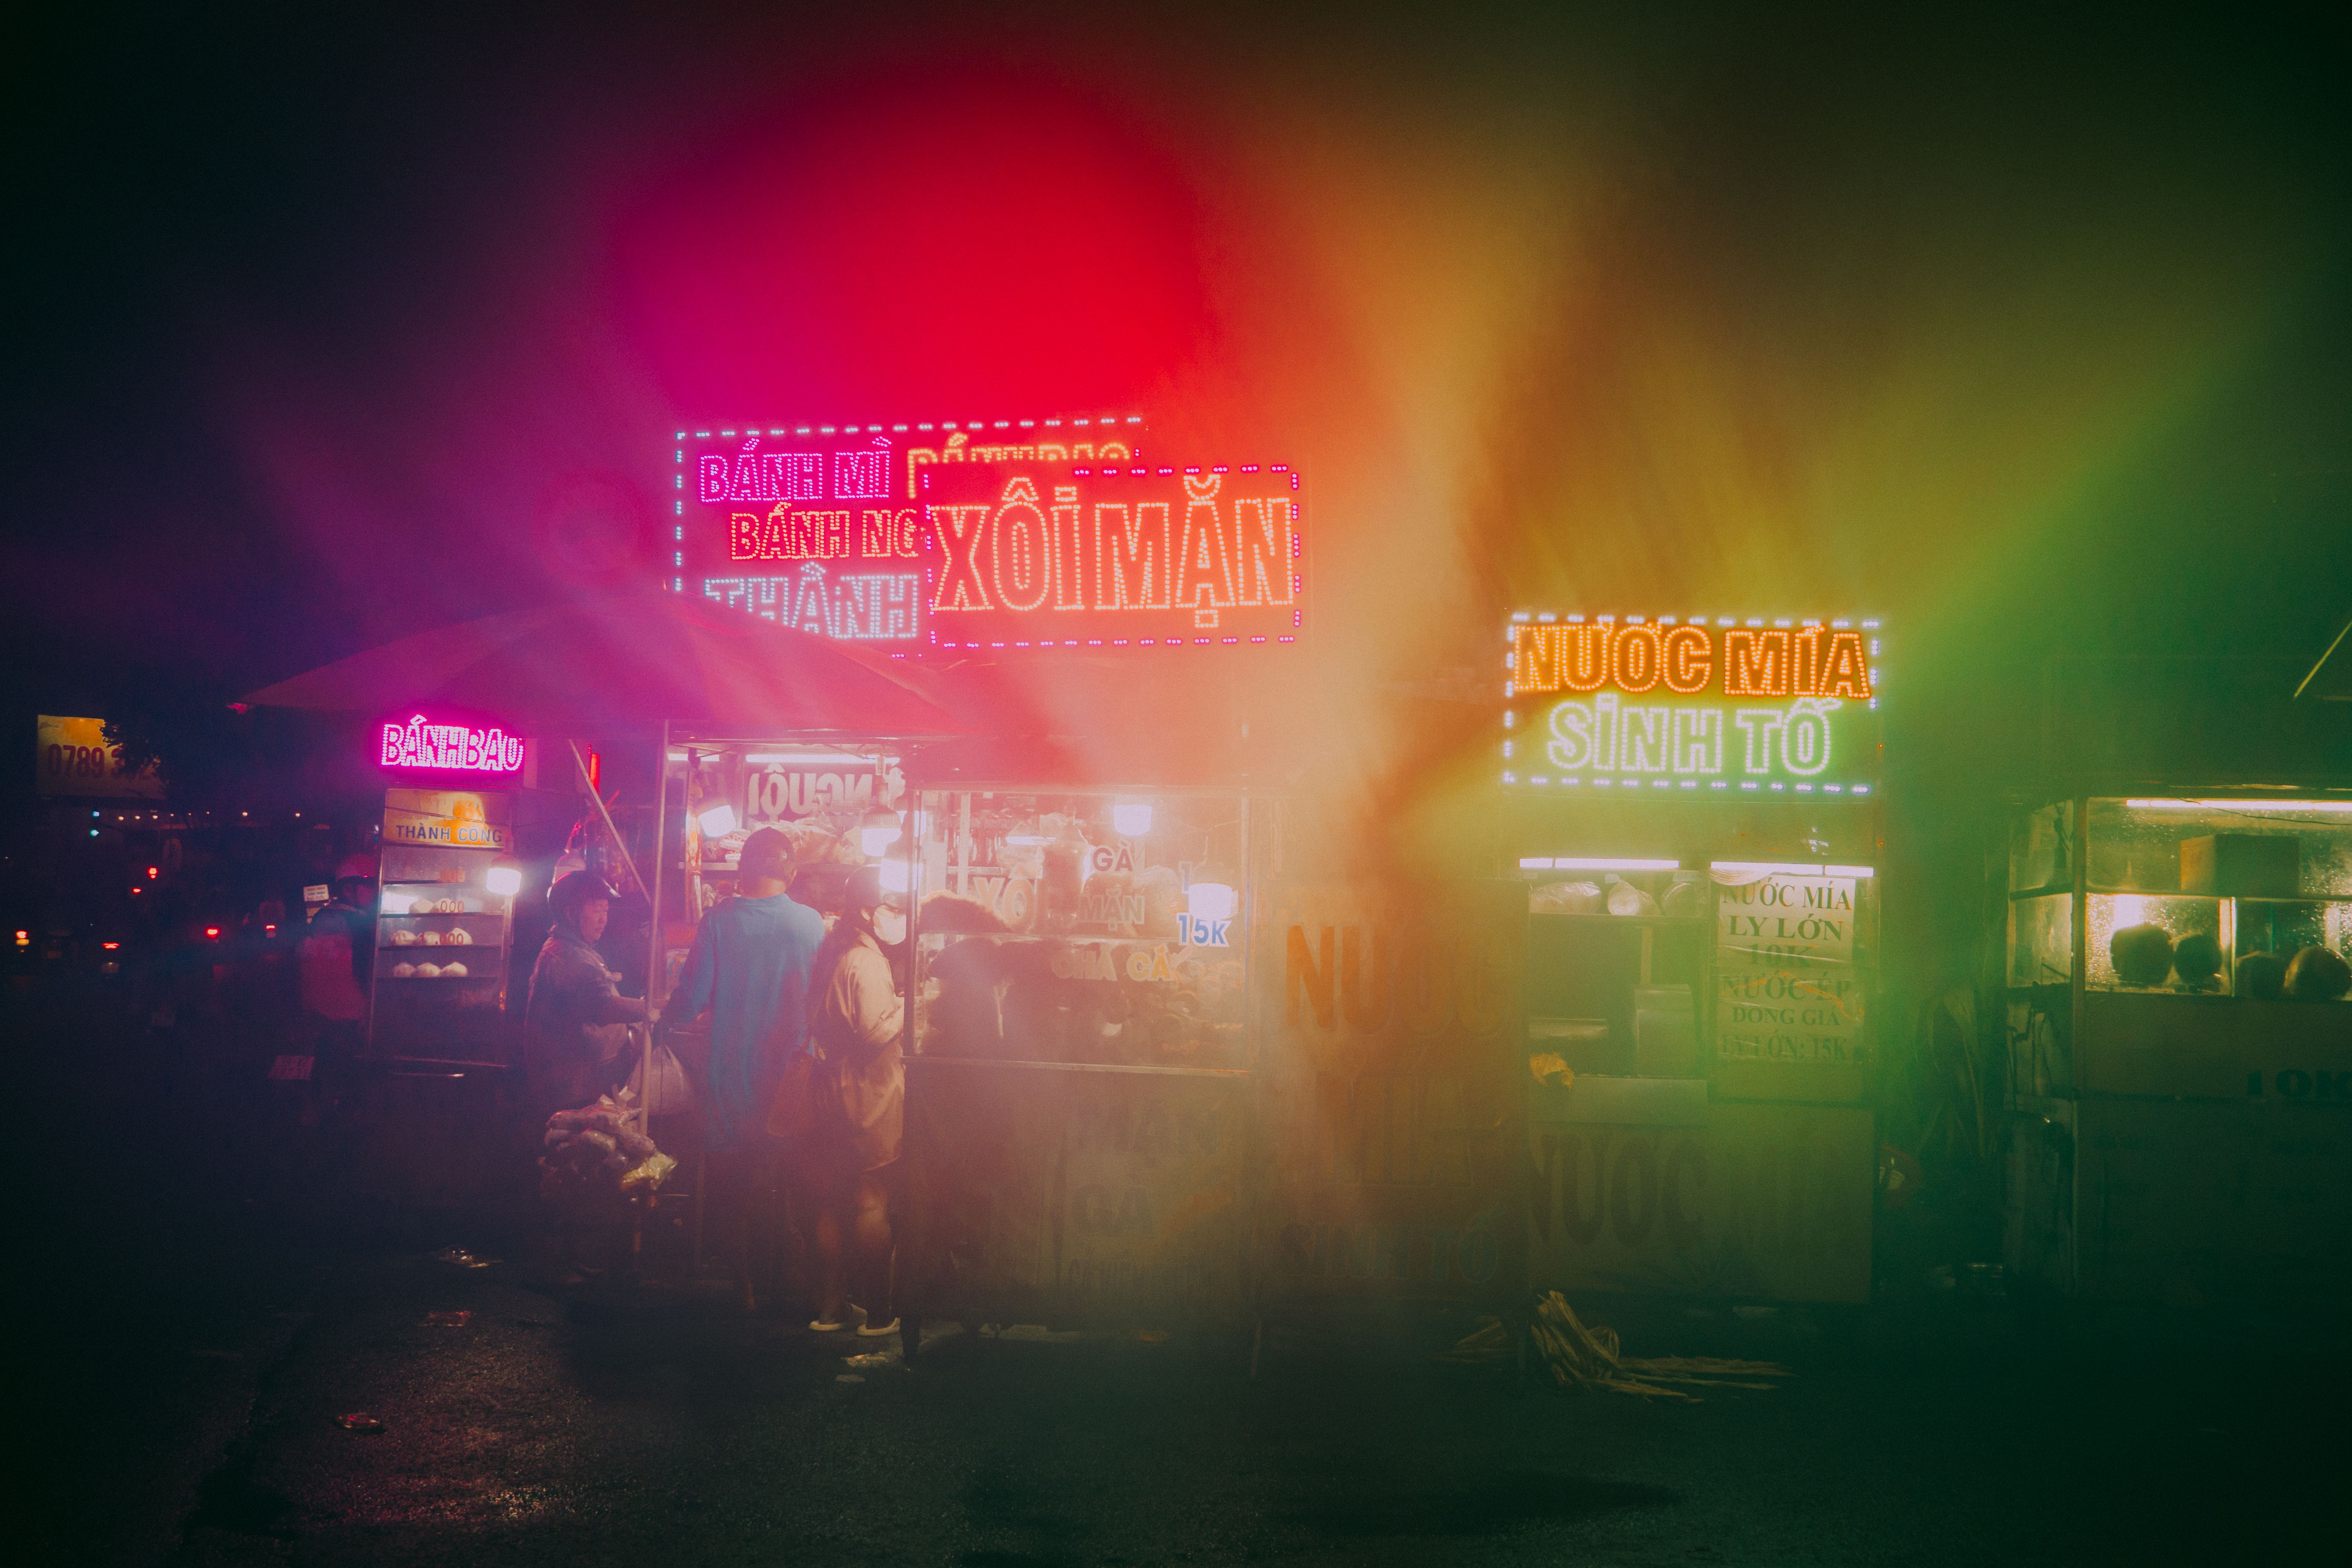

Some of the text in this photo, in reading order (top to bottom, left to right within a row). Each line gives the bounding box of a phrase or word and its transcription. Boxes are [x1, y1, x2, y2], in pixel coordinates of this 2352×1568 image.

[700, 438, 823, 503] BÁNH
[835, 435, 891, 499] MÌ
[731, 501, 850, 560] BÁNH
[1094, 474, 1294, 627] MẶN
[1725, 625, 1872, 698] MÍA
[1736, 696, 1843, 775] TỐ
[47, 743, 105, 779] 0789
[396, 822, 503, 842] THÀNH CÔNG
[1091, 838, 1135, 873] GÀ
[1722, 877, 1852, 910] NƯỚC MÍA
[1177, 914, 1230, 946] 15K
[1728, 913, 1845, 941] LY LỚN
[1127, 944, 1174, 981] CÁ
[1748, 943, 1814, 968] 10K
